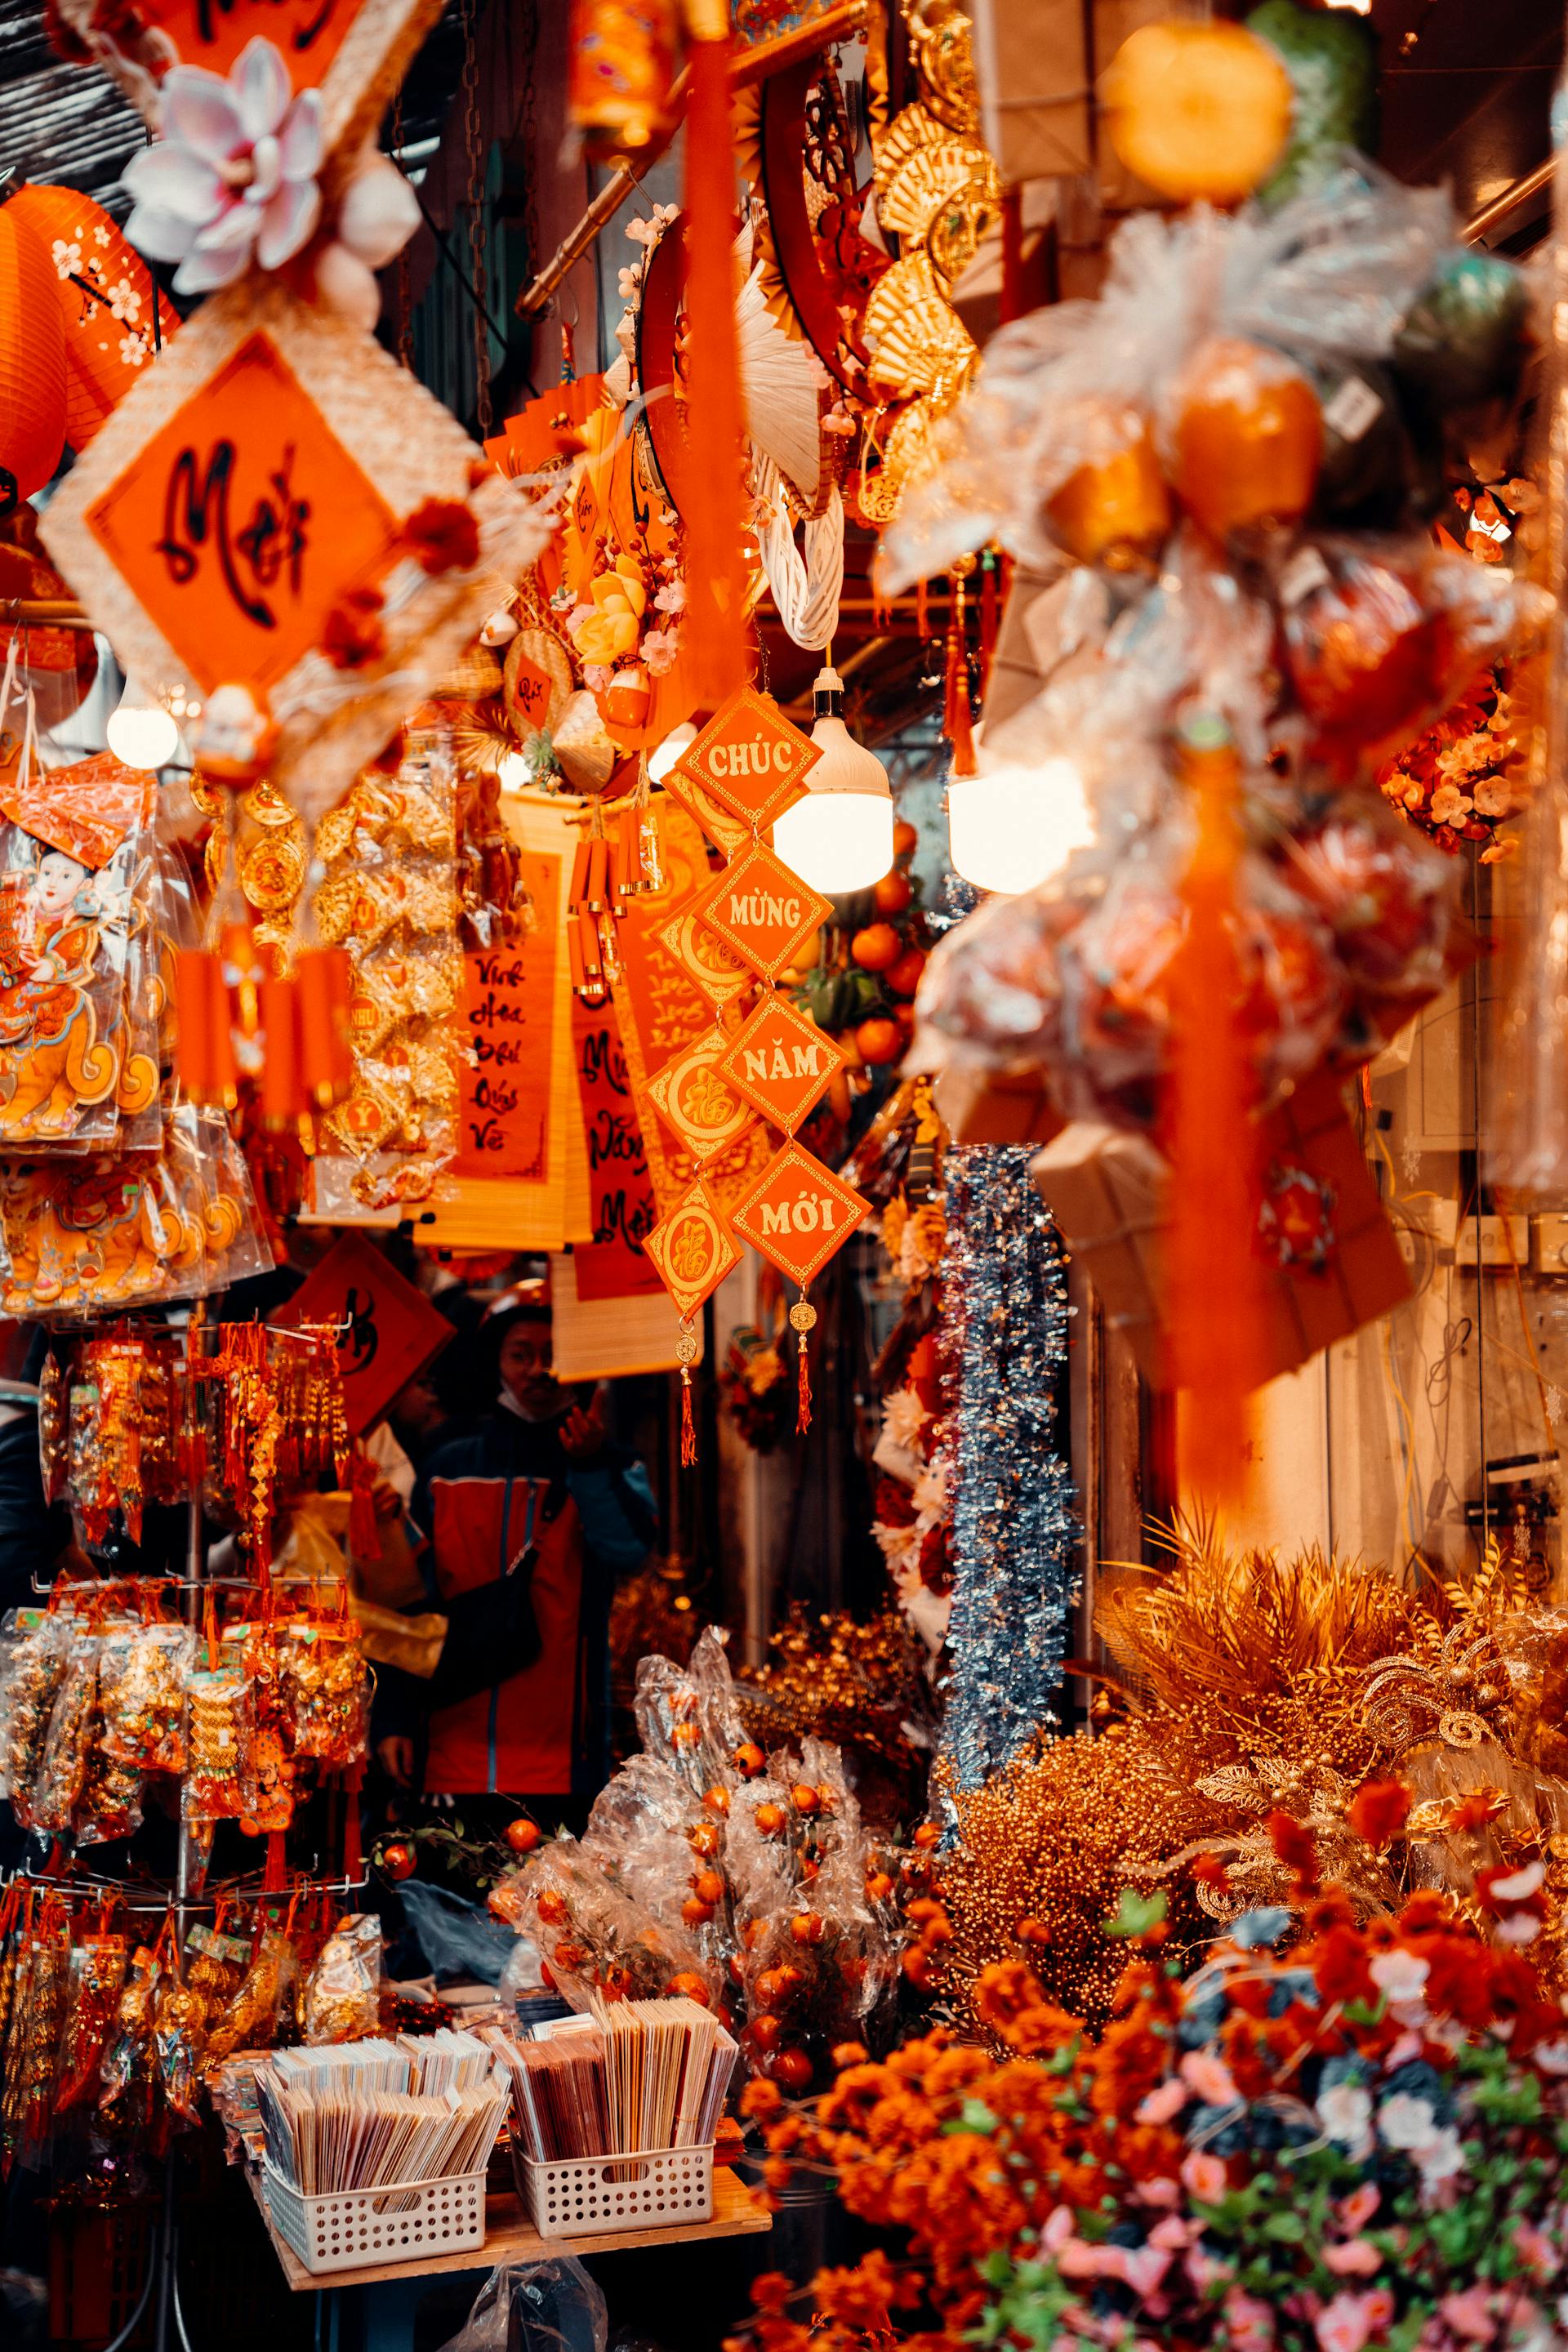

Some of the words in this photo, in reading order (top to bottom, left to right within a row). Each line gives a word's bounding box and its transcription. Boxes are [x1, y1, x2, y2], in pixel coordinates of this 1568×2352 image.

[708, 733, 792, 777] CHÚC
[730, 887, 801, 928] MỪNG
[742, 1037, 820, 1081] NĂM
[760, 1190, 835, 1235] MỚI
